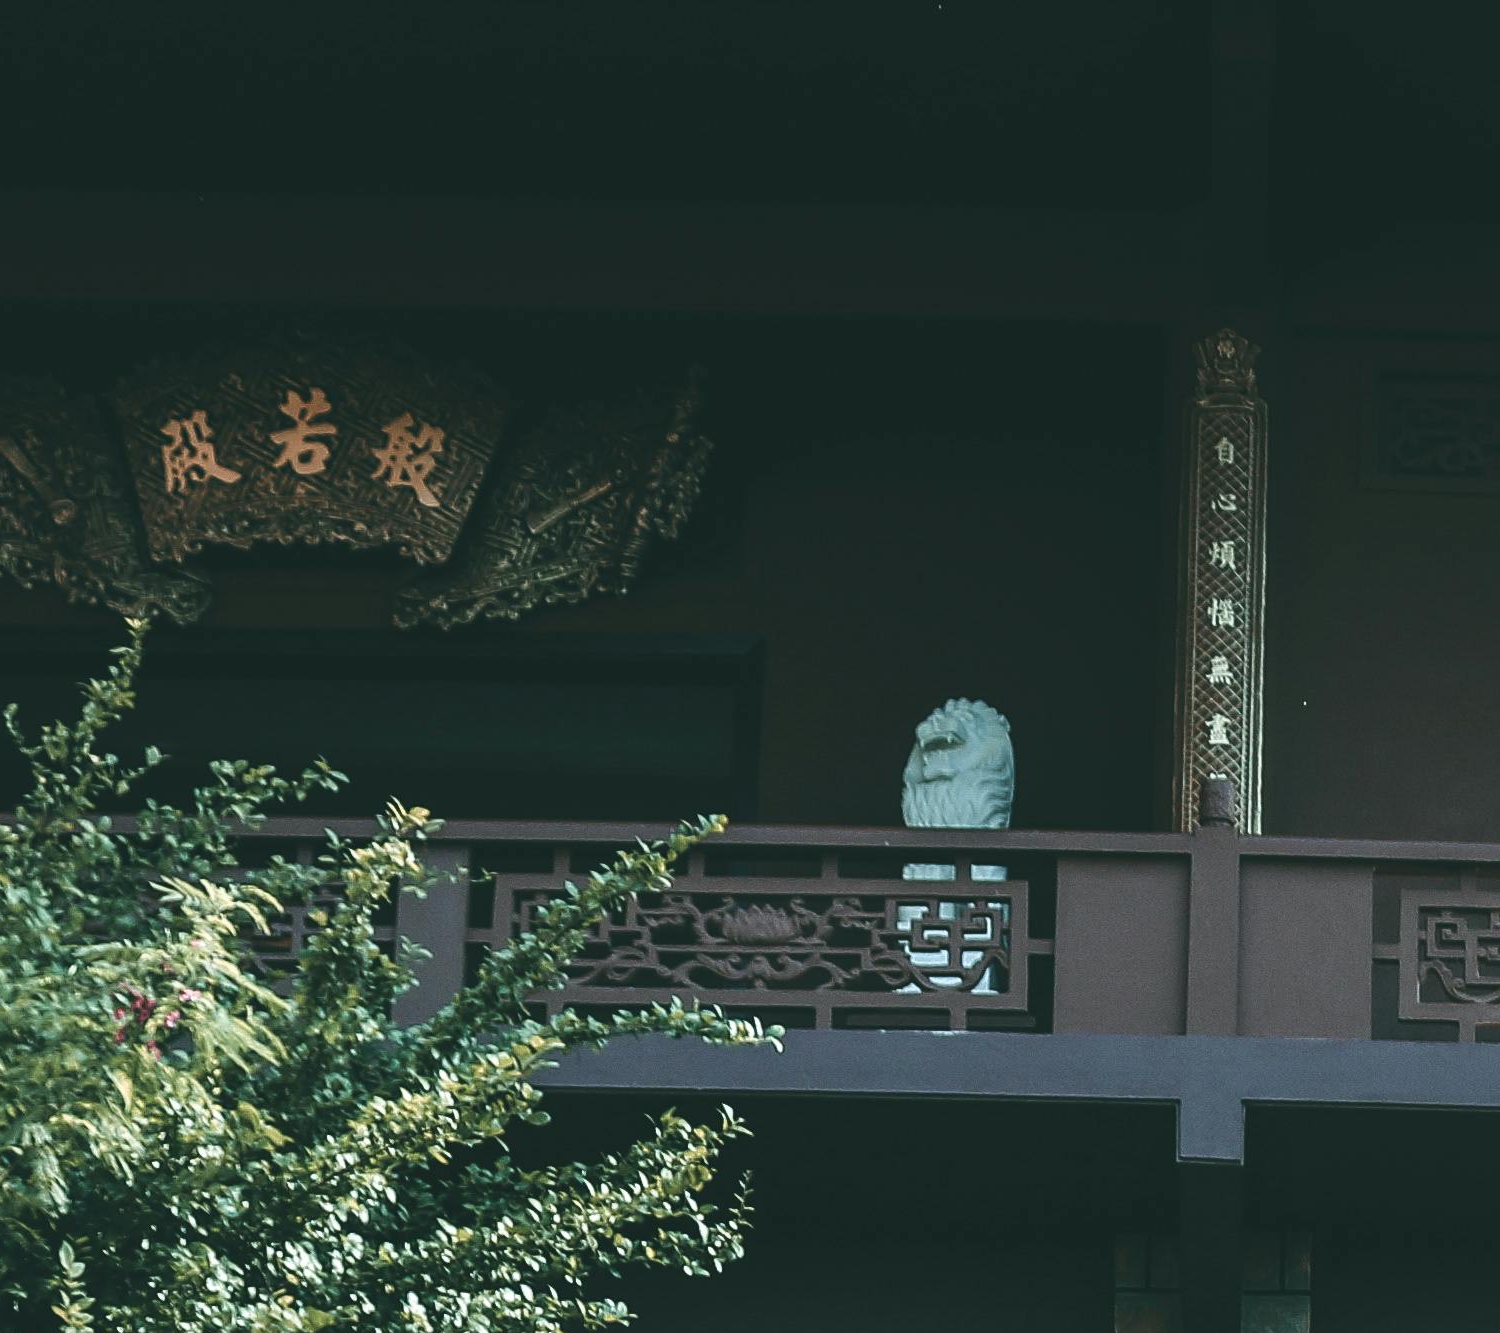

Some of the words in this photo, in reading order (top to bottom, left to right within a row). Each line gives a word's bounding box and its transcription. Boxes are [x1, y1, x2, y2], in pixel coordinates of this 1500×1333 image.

[1205, 437, 1238, 780] 自心煩惱無盡
